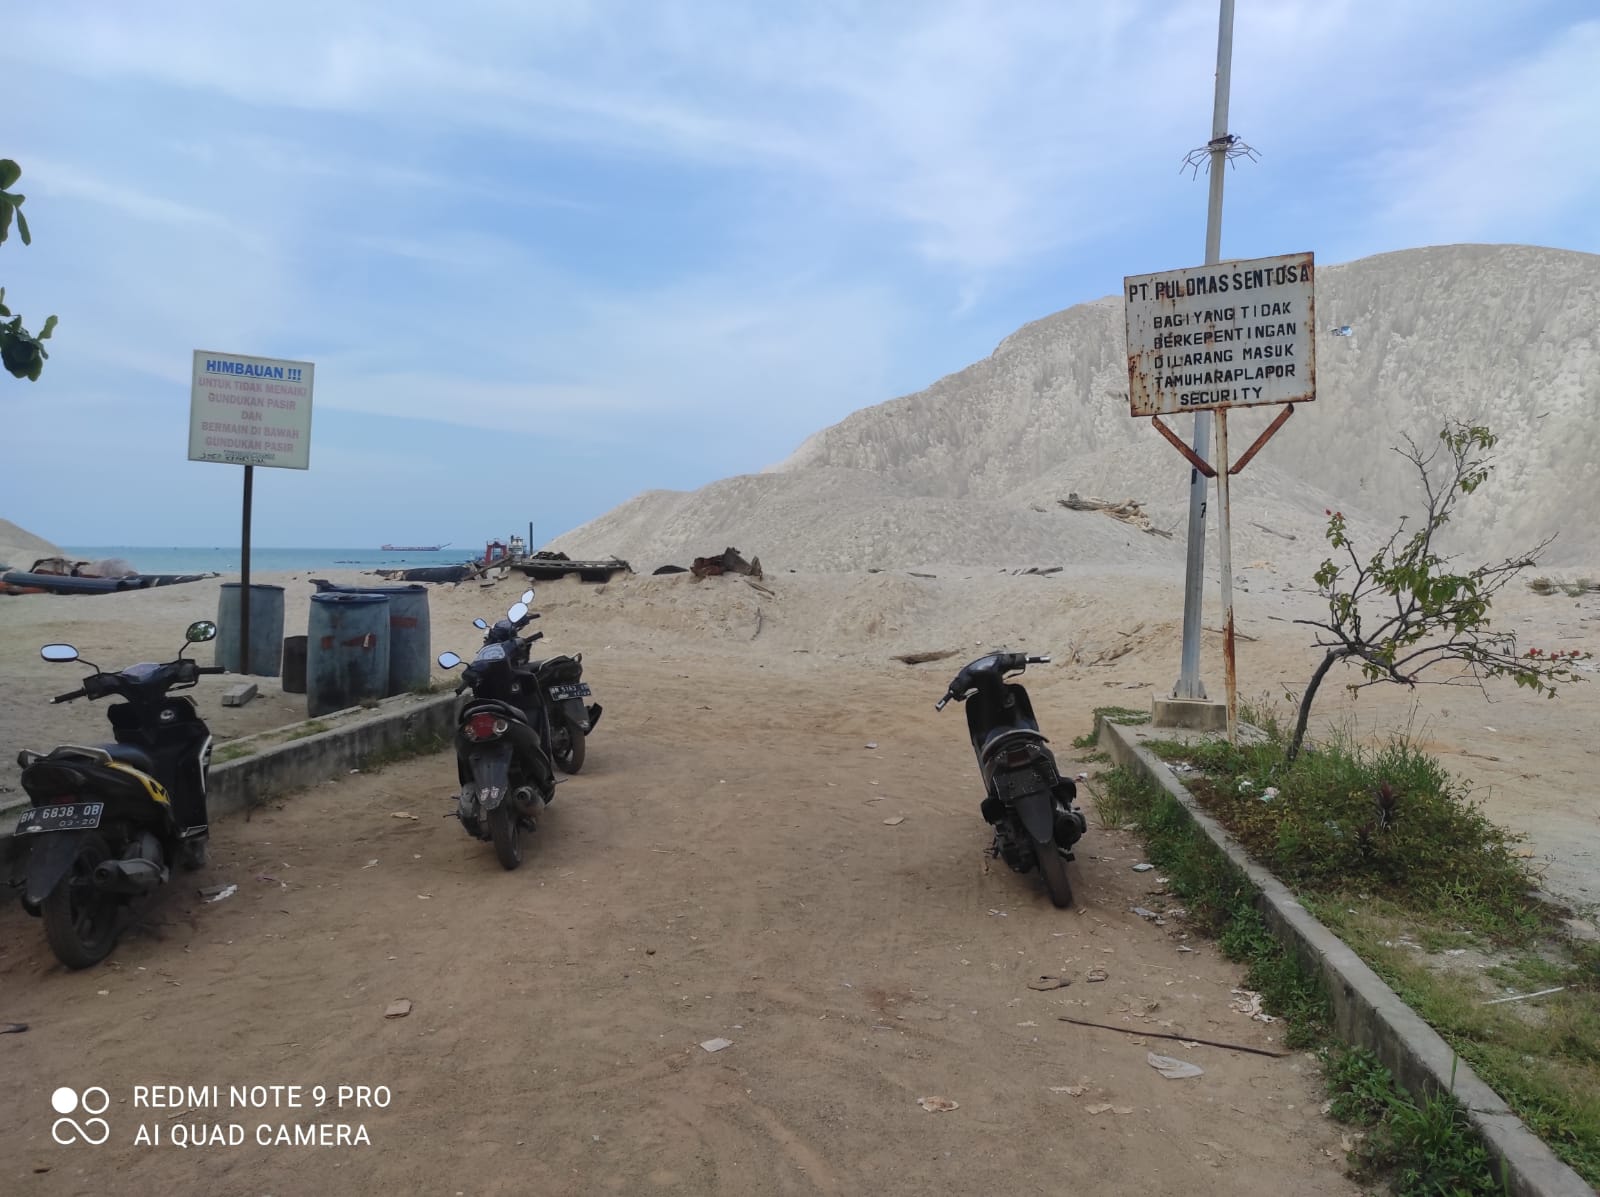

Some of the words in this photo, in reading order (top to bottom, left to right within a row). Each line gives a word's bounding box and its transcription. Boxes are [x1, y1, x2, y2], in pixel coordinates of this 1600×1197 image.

[1233, 263, 1310, 291] SENTOSA
[1241, 301, 1292, 319] TIDAK
[1154, 322, 1297, 350] BERKEPENTINGAN
[1154, 349, 1234, 369] DILARANG
[1242, 343, 1294, 361] MASUK
[206, 359, 284, 379] HIMBAUAN
[198, 376, 232, 391] UNTUK
[234, 380, 262, 393] TIDAK
[265, 383, 308, 398] MENAIKI
[1180, 386, 1263, 407] SECURITY
[208, 392, 265, 408] GUNDUKAN
[267, 397, 297, 411] PASIR
[241, 410, 263, 422] DAN
[201, 421, 249, 436] BERMAIN
[251, 425, 262, 436] DI
[264, 427, 300, 440] BAWAH
[205, 436, 262, 450] GUNDUKAN
[264, 440, 295, 453] PASIR
[42, 806, 74, 819] 6838
